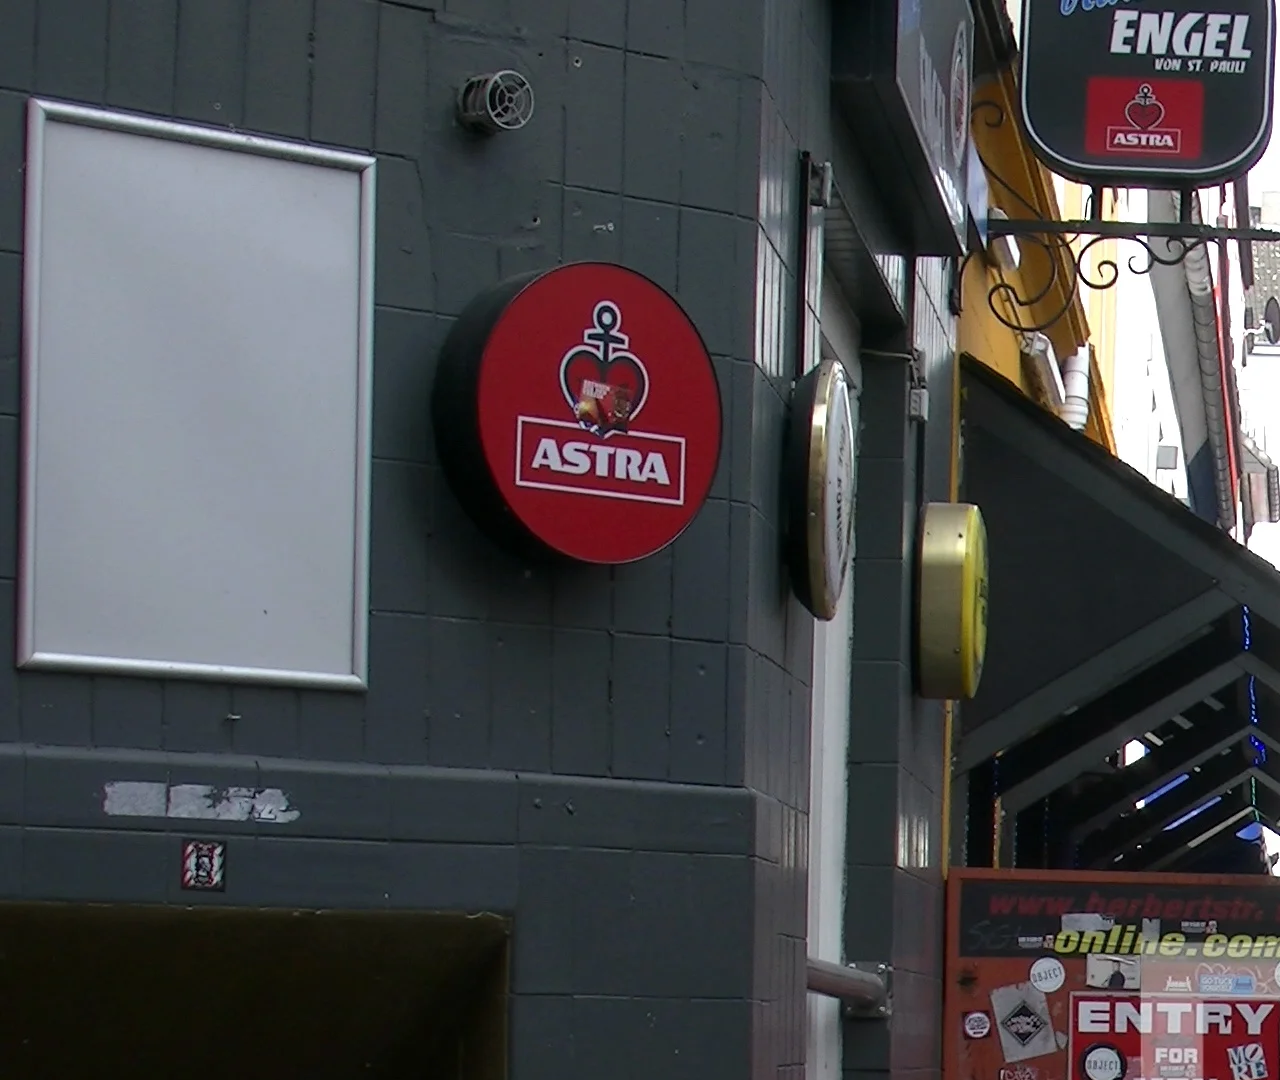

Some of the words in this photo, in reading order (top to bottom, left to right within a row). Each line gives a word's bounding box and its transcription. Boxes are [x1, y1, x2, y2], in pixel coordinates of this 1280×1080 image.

[1110, 9, 1252, 59] ENGEL
[1154, 58, 1182, 71] VON
[1187, 59, 1204, 72] ST.
[1209, 59, 1246, 74] PAULI
[1113, 133, 1174, 147] ASTRA
[531, 437, 671, 486] ASTRA
[1032, 966, 1063, 983] OBJECT
[1077, 1001, 1275, 1034] ENTRY
[1155, 1047, 1198, 1064] FOR
[1086, 1058, 1120, 1072] OBJECT
